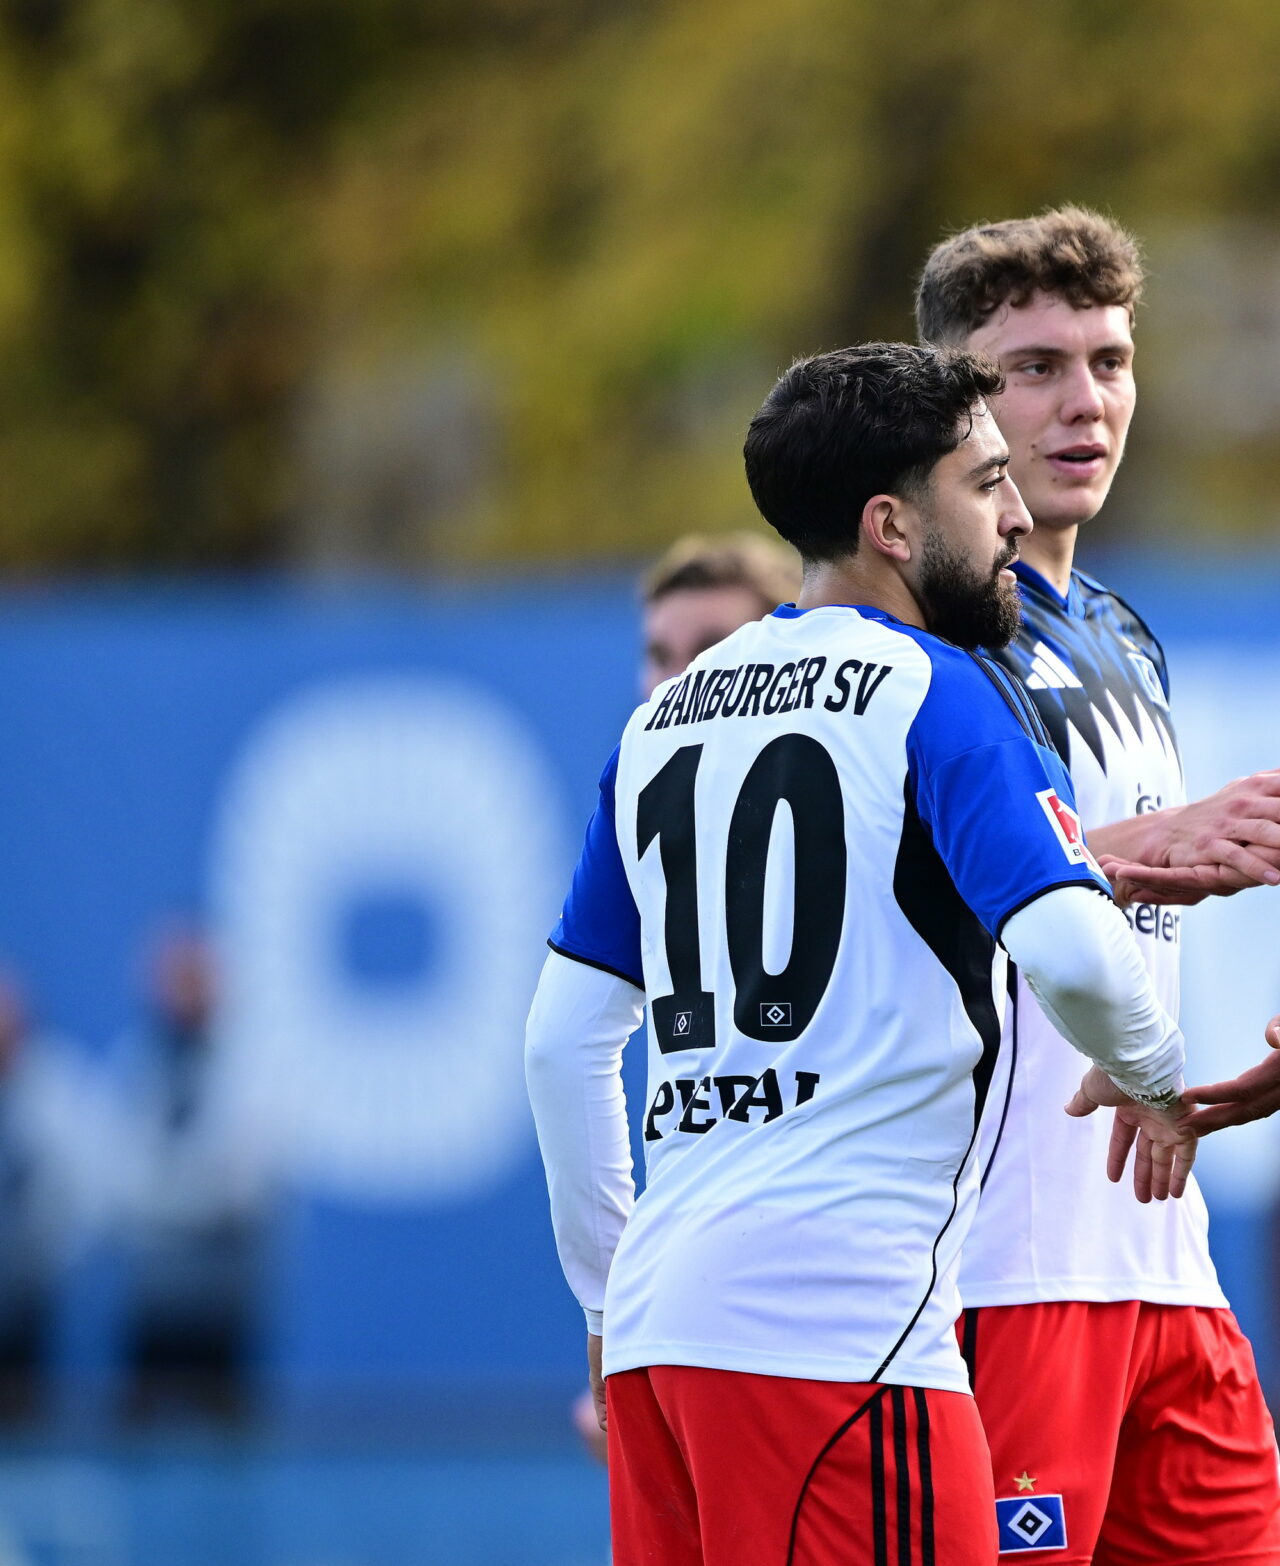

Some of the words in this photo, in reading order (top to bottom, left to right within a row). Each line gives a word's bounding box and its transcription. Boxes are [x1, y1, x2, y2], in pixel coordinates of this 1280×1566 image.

[643, 655, 827, 731] HAMBURGER
[823, 658, 894, 717] SV
[636, 732, 848, 1055] 10
